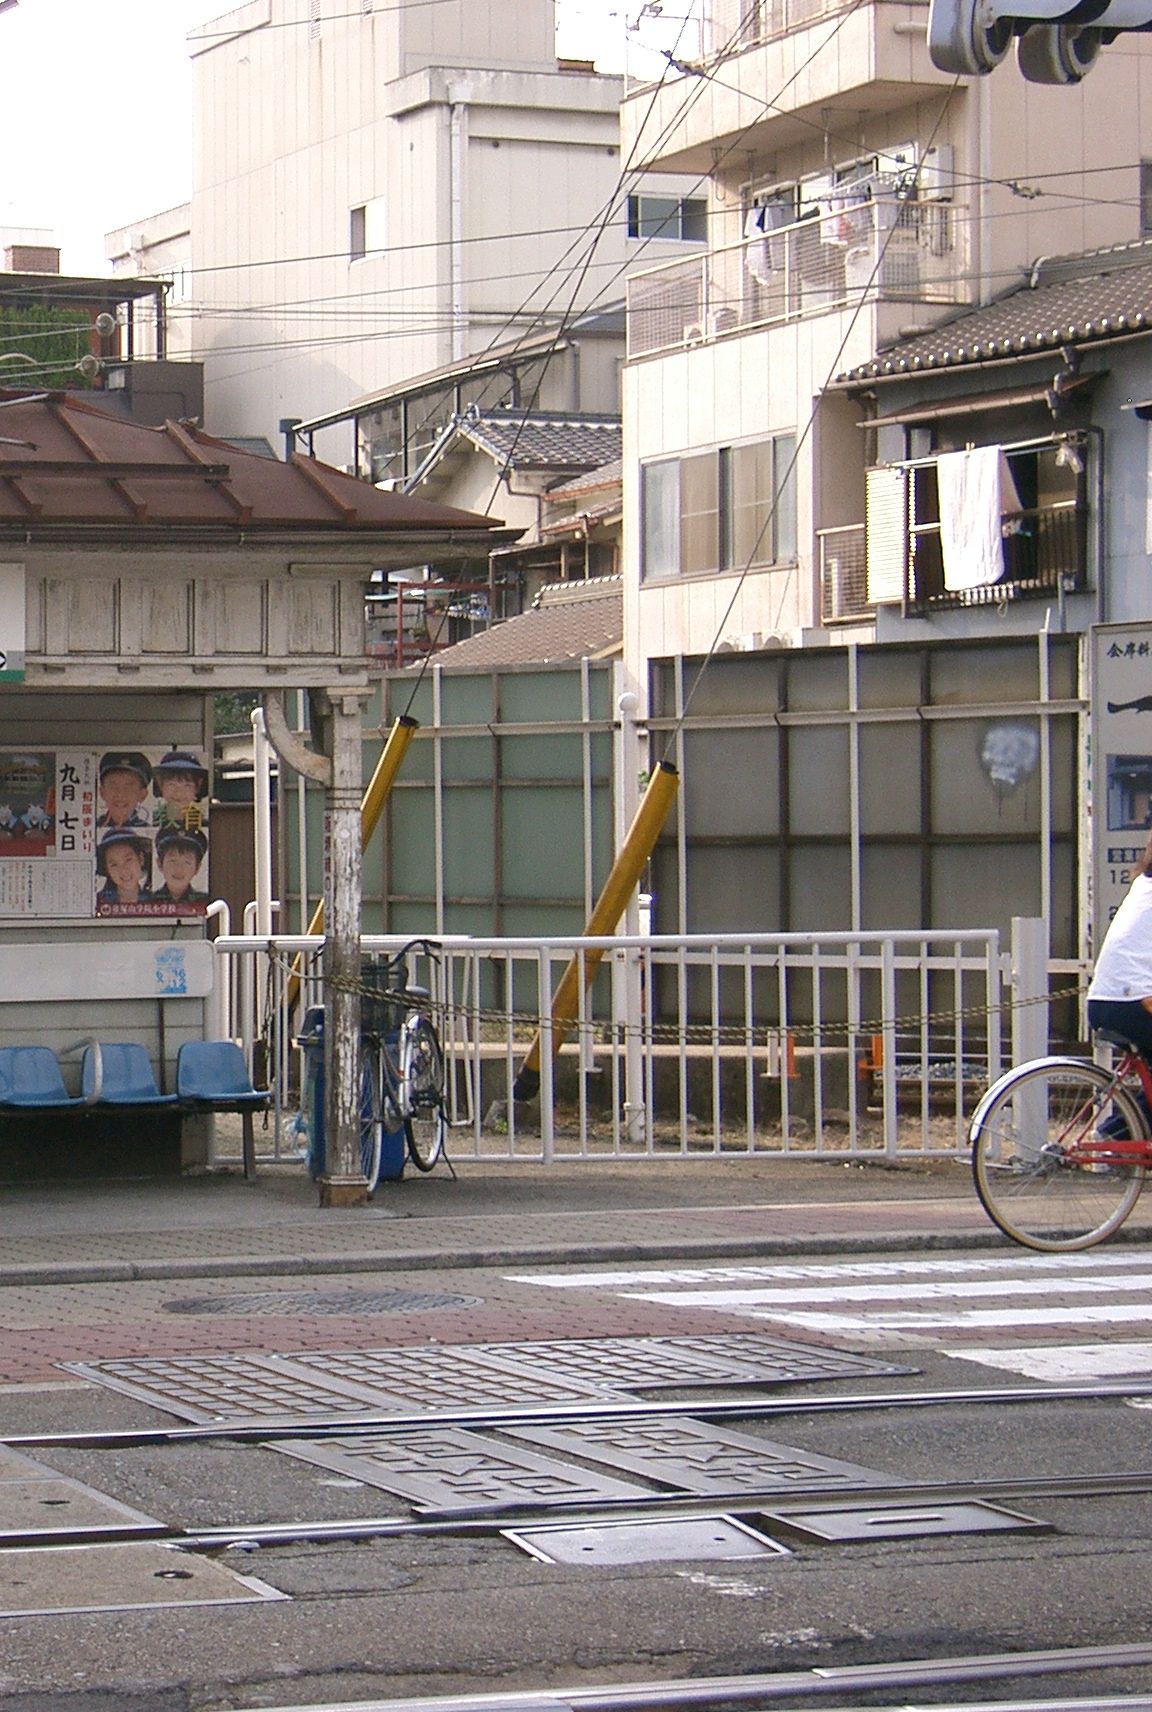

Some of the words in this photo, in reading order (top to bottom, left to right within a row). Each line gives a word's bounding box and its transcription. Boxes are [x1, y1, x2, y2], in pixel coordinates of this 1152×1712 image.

[1107, 641, 1152, 659] 会席料
[59, 763, 80, 850] 九月七日
